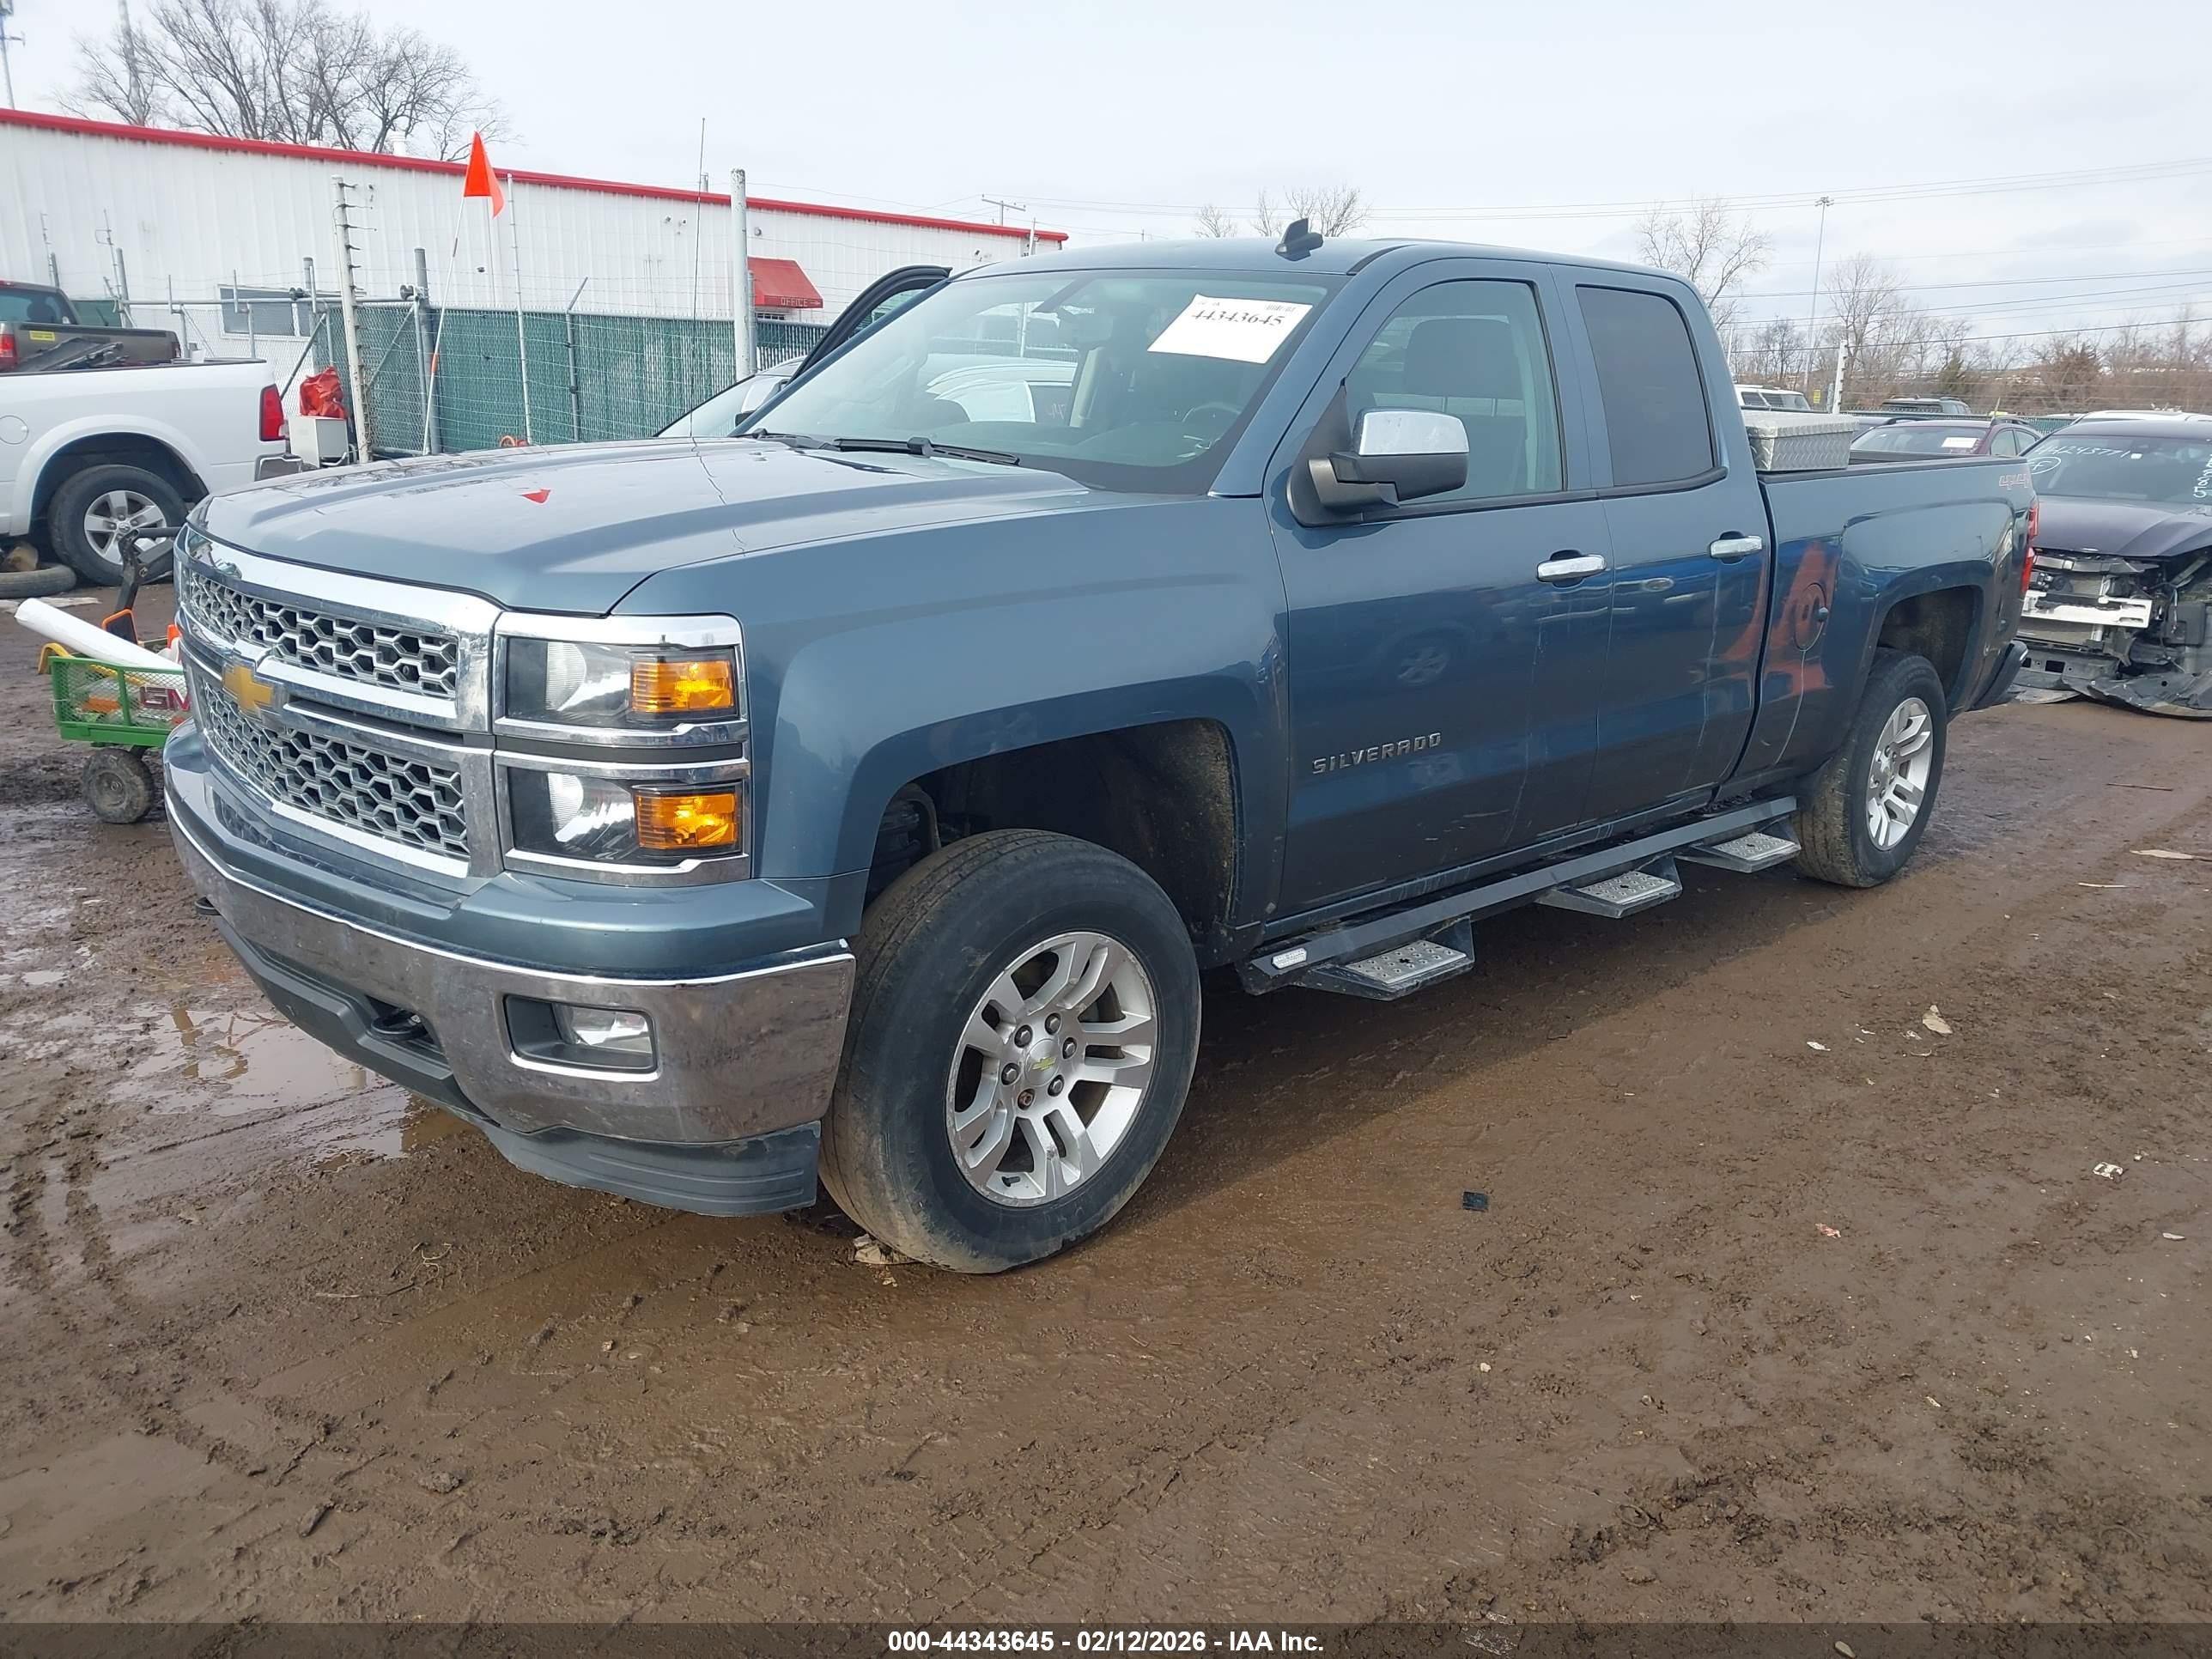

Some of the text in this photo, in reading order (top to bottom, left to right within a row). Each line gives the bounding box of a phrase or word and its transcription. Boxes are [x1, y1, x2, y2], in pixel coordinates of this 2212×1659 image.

[781, 296, 808, 307] OFFICE
[1192, 310, 1285, 326] 44343645
[140, 686, 193, 712] GM
[1312, 732, 1443, 775] SILVERADO
